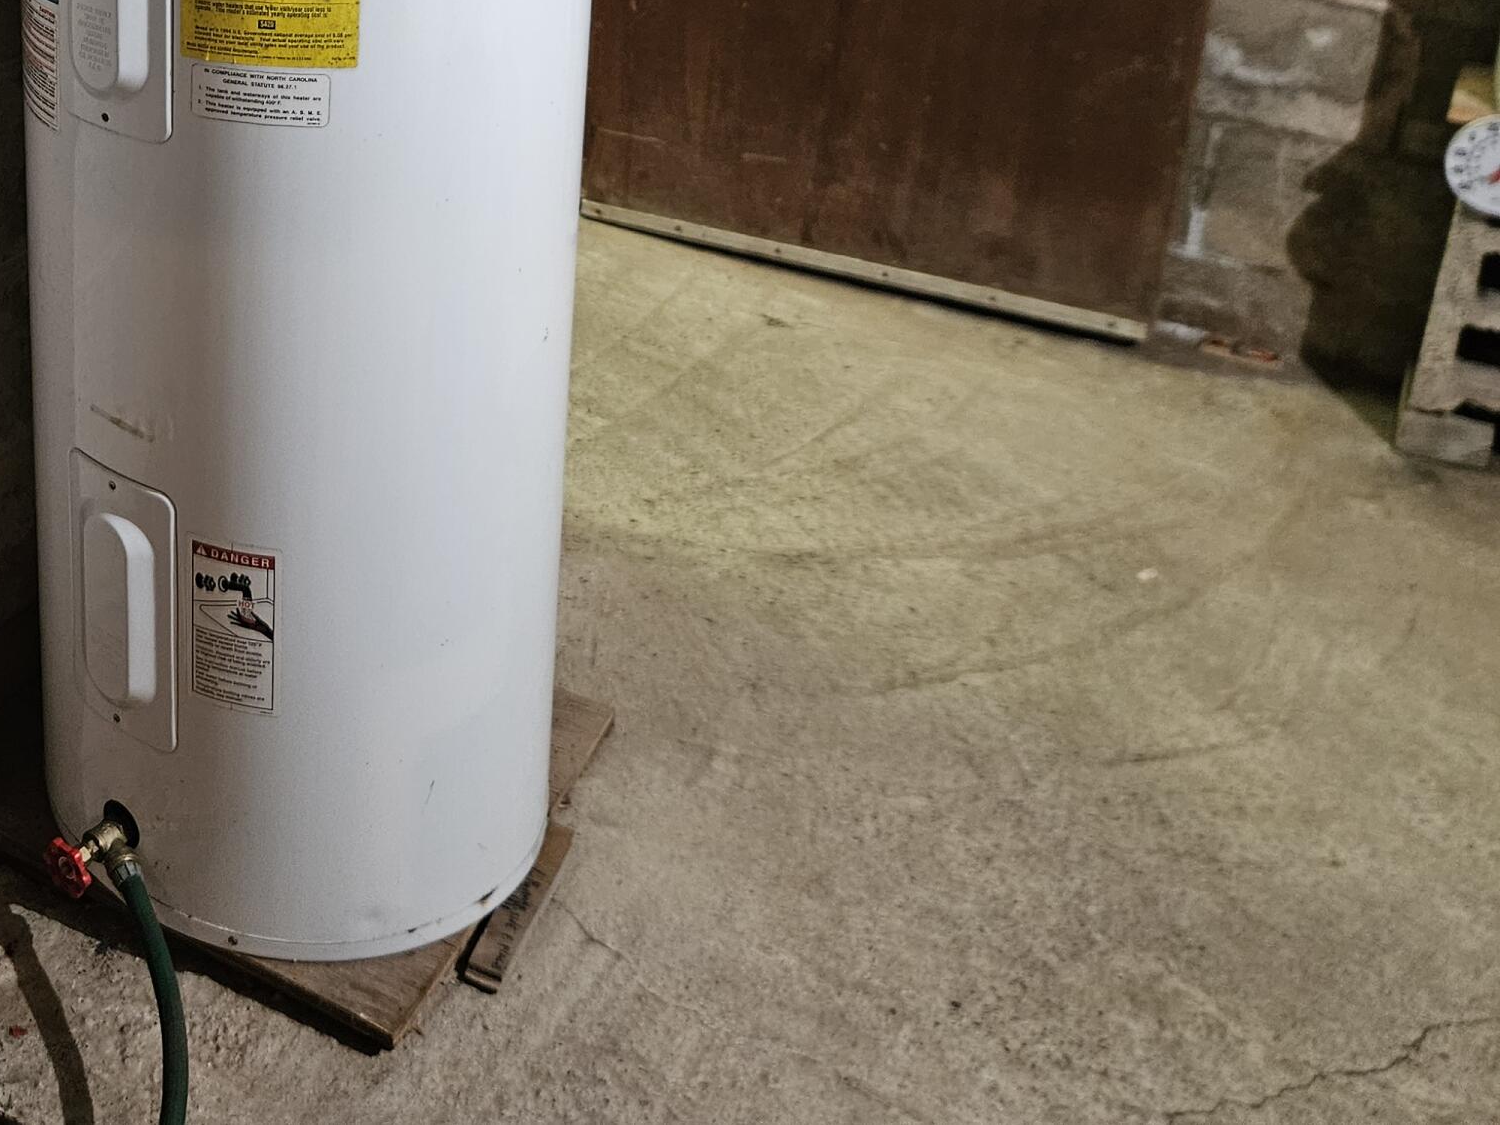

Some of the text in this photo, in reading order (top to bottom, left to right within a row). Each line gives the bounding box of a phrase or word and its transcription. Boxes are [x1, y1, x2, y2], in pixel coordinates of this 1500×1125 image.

[211, 69, 247, 78] COMPLIANCE
[223, 78, 247, 86] GENERAL
[210, 548, 270, 568] DANGER
